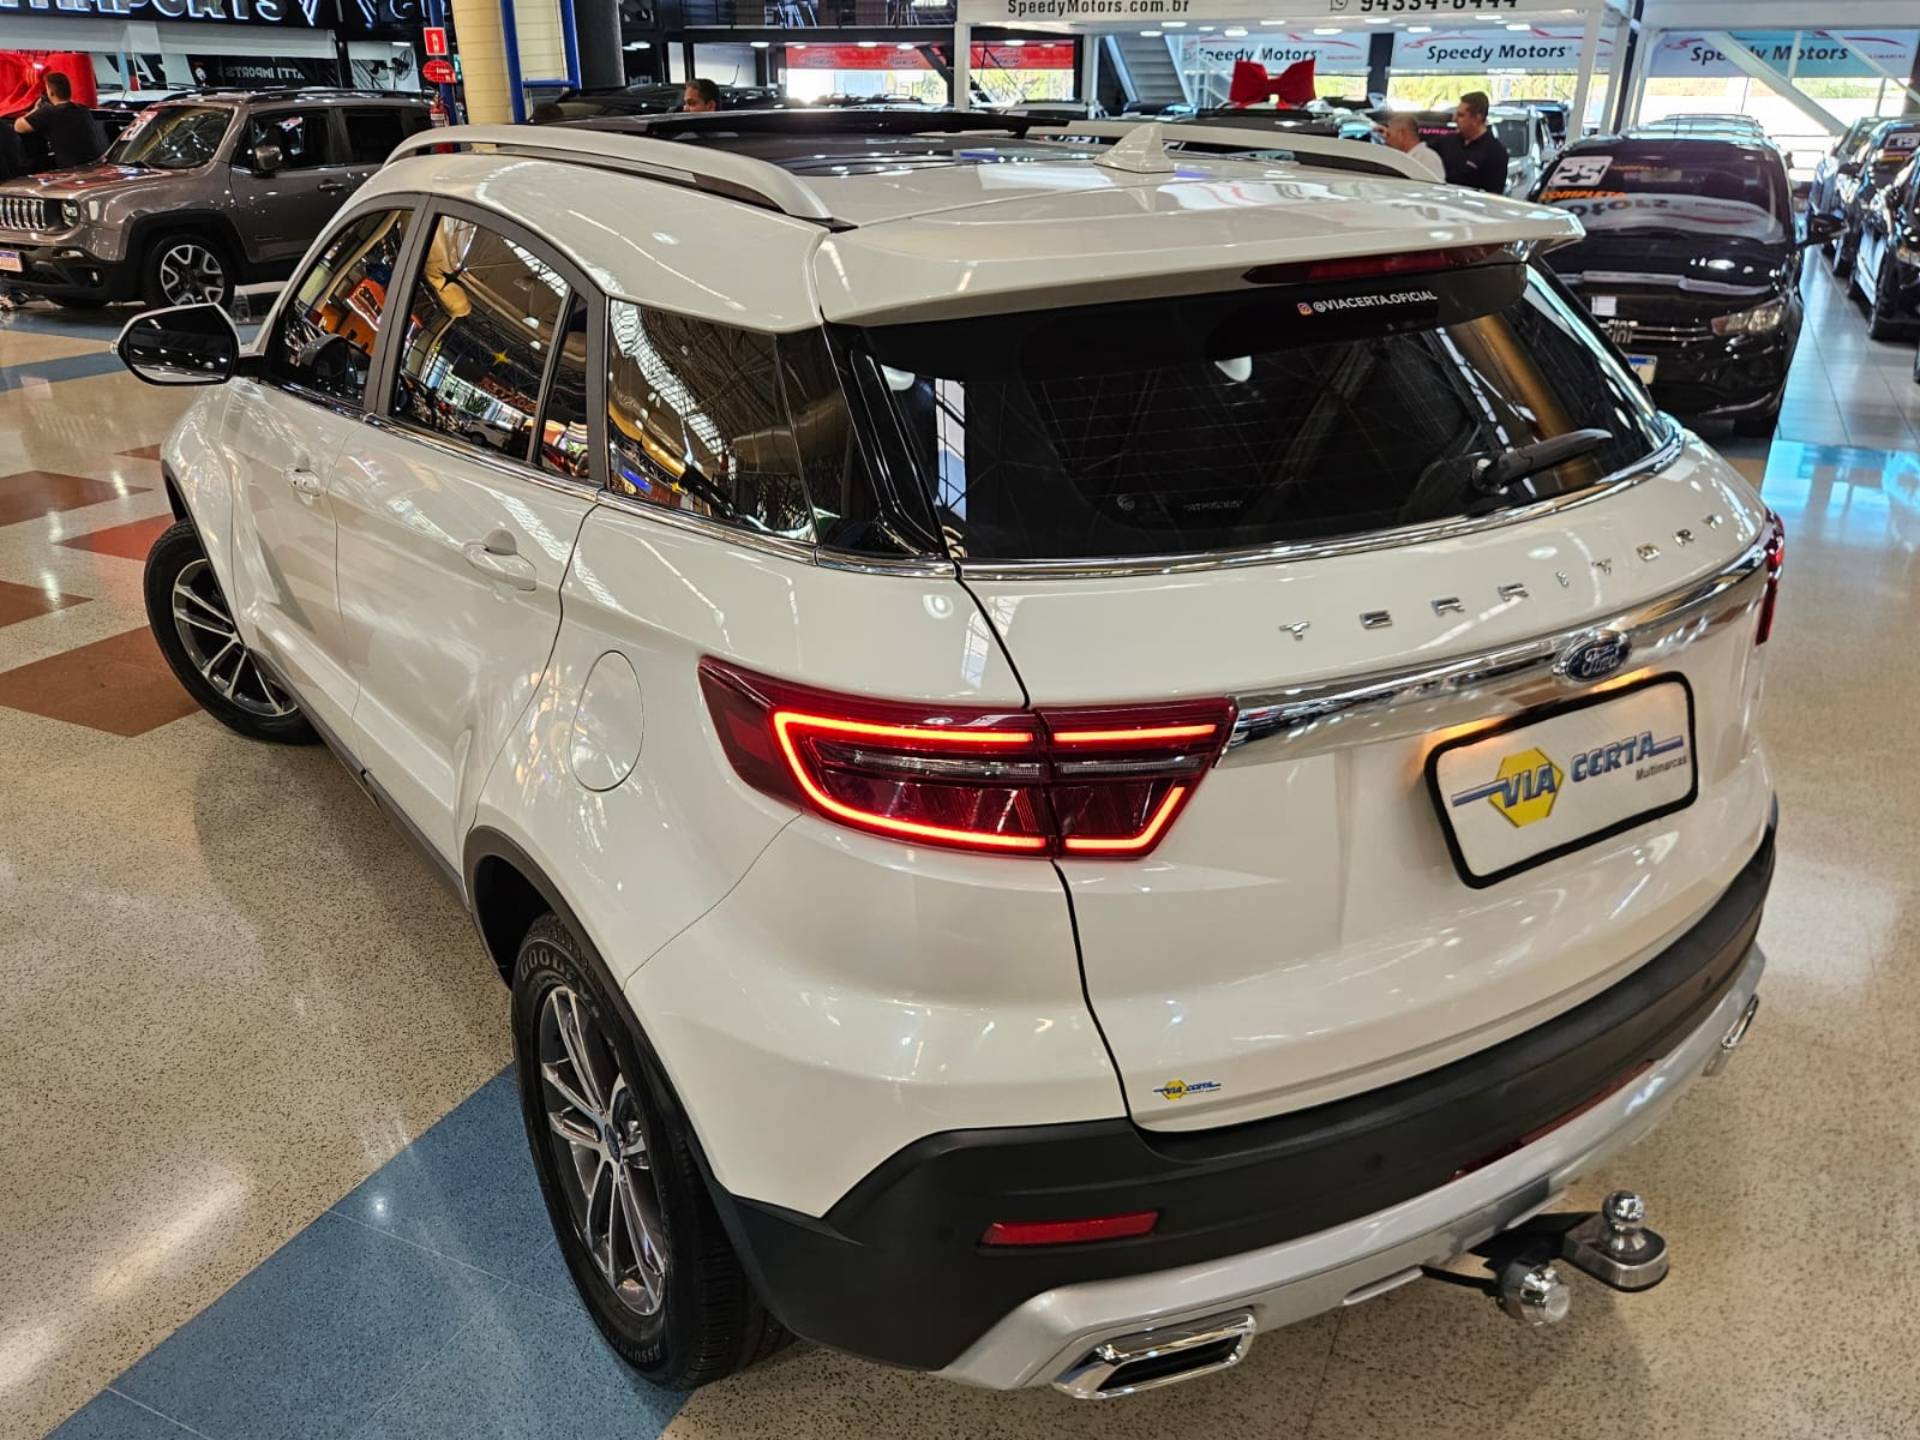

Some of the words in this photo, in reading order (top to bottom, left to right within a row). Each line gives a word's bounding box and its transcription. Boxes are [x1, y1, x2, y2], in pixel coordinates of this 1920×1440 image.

[1007, 0, 1189, 17] SpeedyMotors.com.br
[1198, 47, 1254, 62] peedy
[1426, 44, 1493, 63] Speedy
[1499, 44, 1566, 59] Motors
[1690, 45, 1765, 66] Spey
[1313, 290, 1438, 313] @VIACERTA.OFICIAL
[1279, 513, 1723, 641] TERRITORY
[1581, 645, 1617, 677] Ford
[1500, 764, 1557, 808] VIA
[1570, 730, 1659, 783] CERTA
[1635, 755, 1688, 781] Multimarcas
